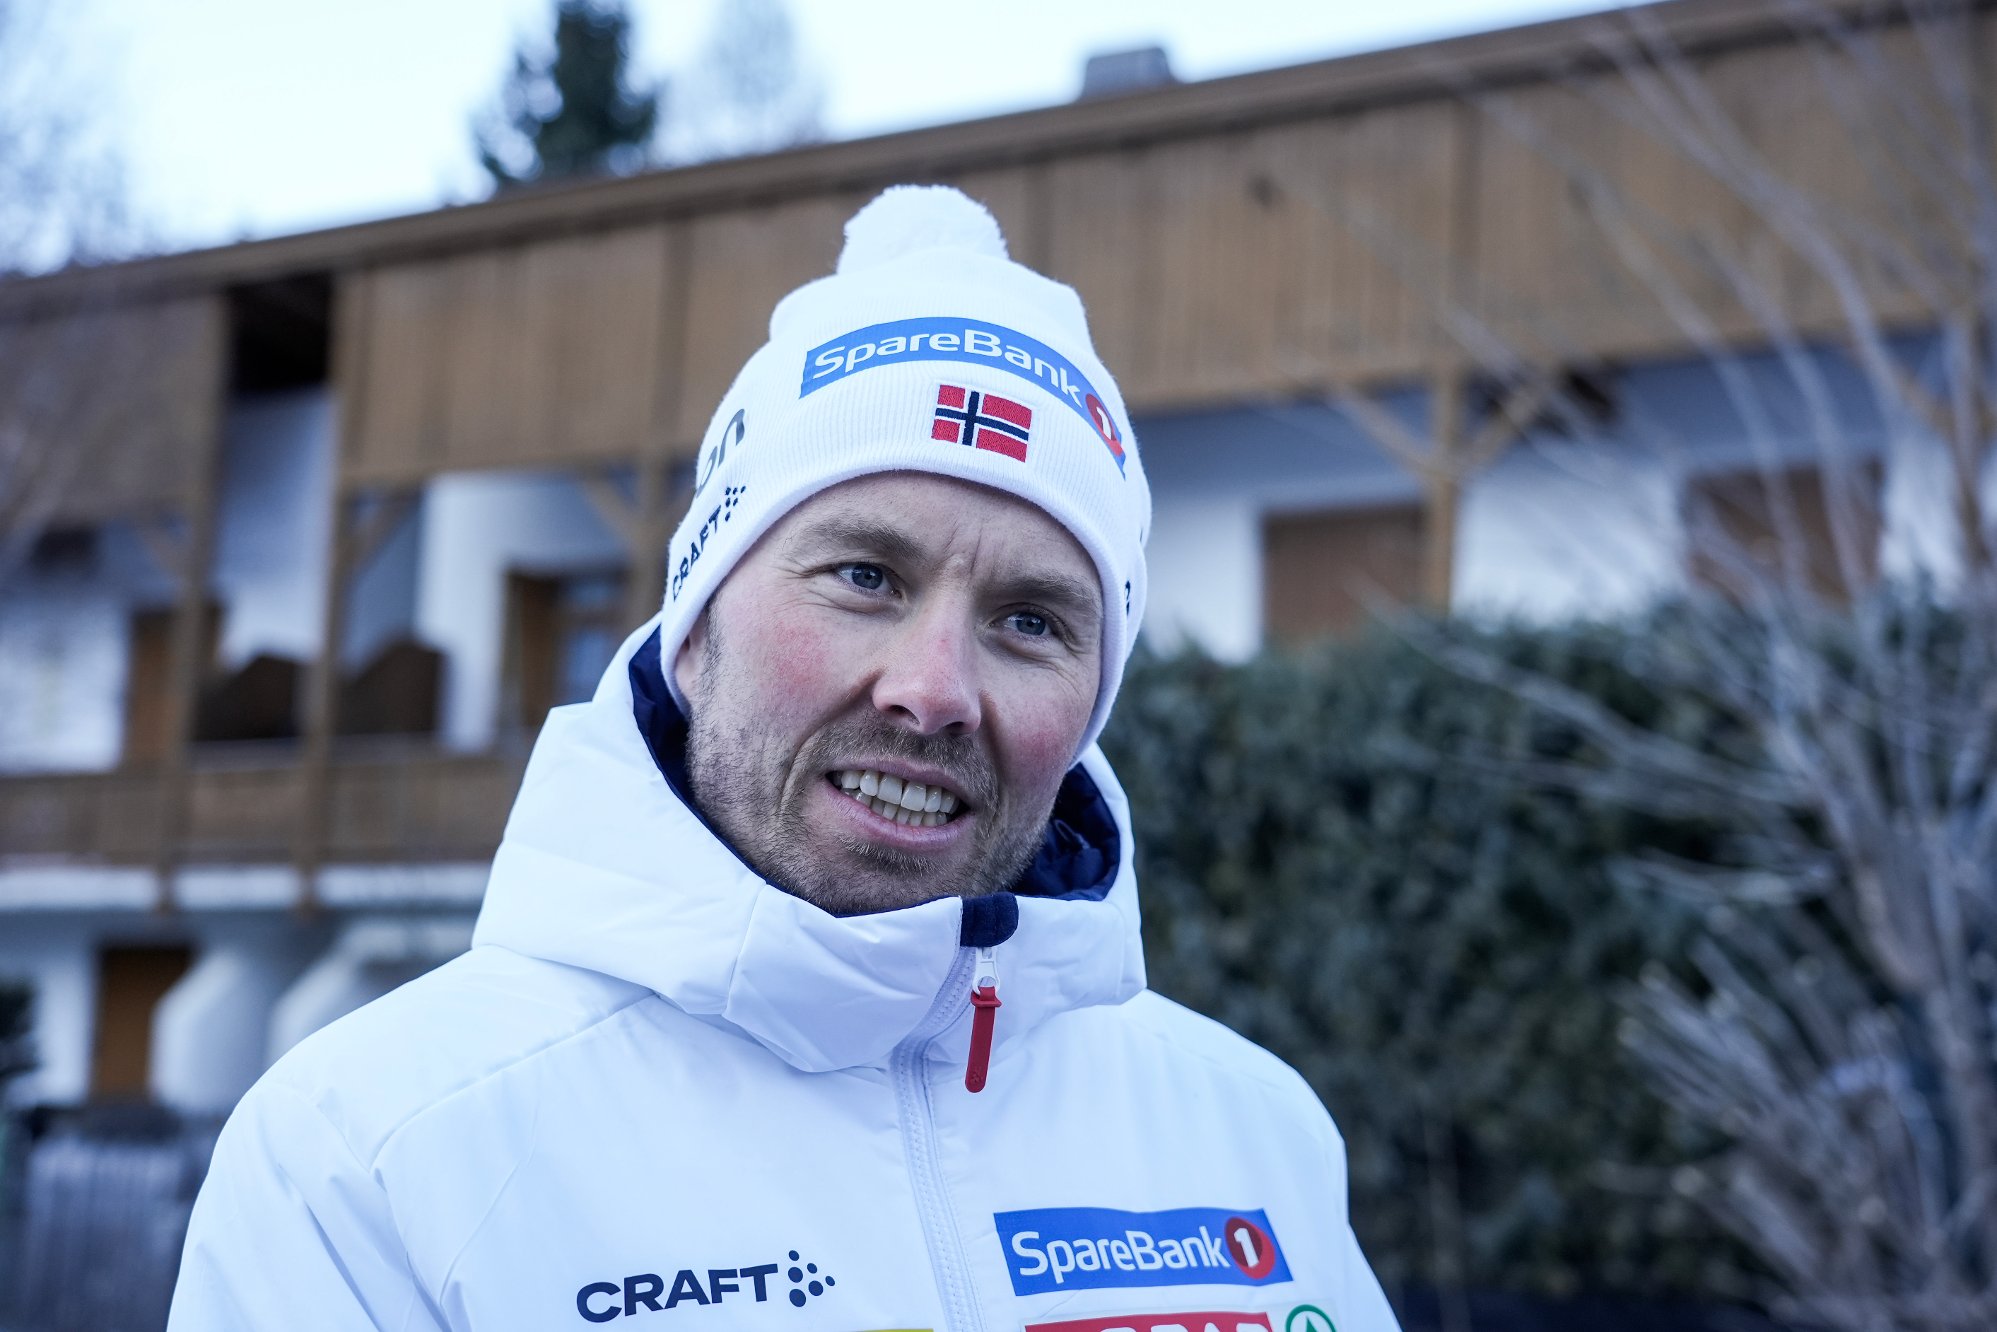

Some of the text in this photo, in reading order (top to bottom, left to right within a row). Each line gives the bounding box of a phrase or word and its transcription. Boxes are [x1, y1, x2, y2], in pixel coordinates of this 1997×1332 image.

[812, 328, 1113, 441] SpareBank 1
[672, 504, 722, 603] CRAFT
[576, 1263, 779, 1324] CRAFT
[1010, 1225, 1261, 1285] SpareBank 1
